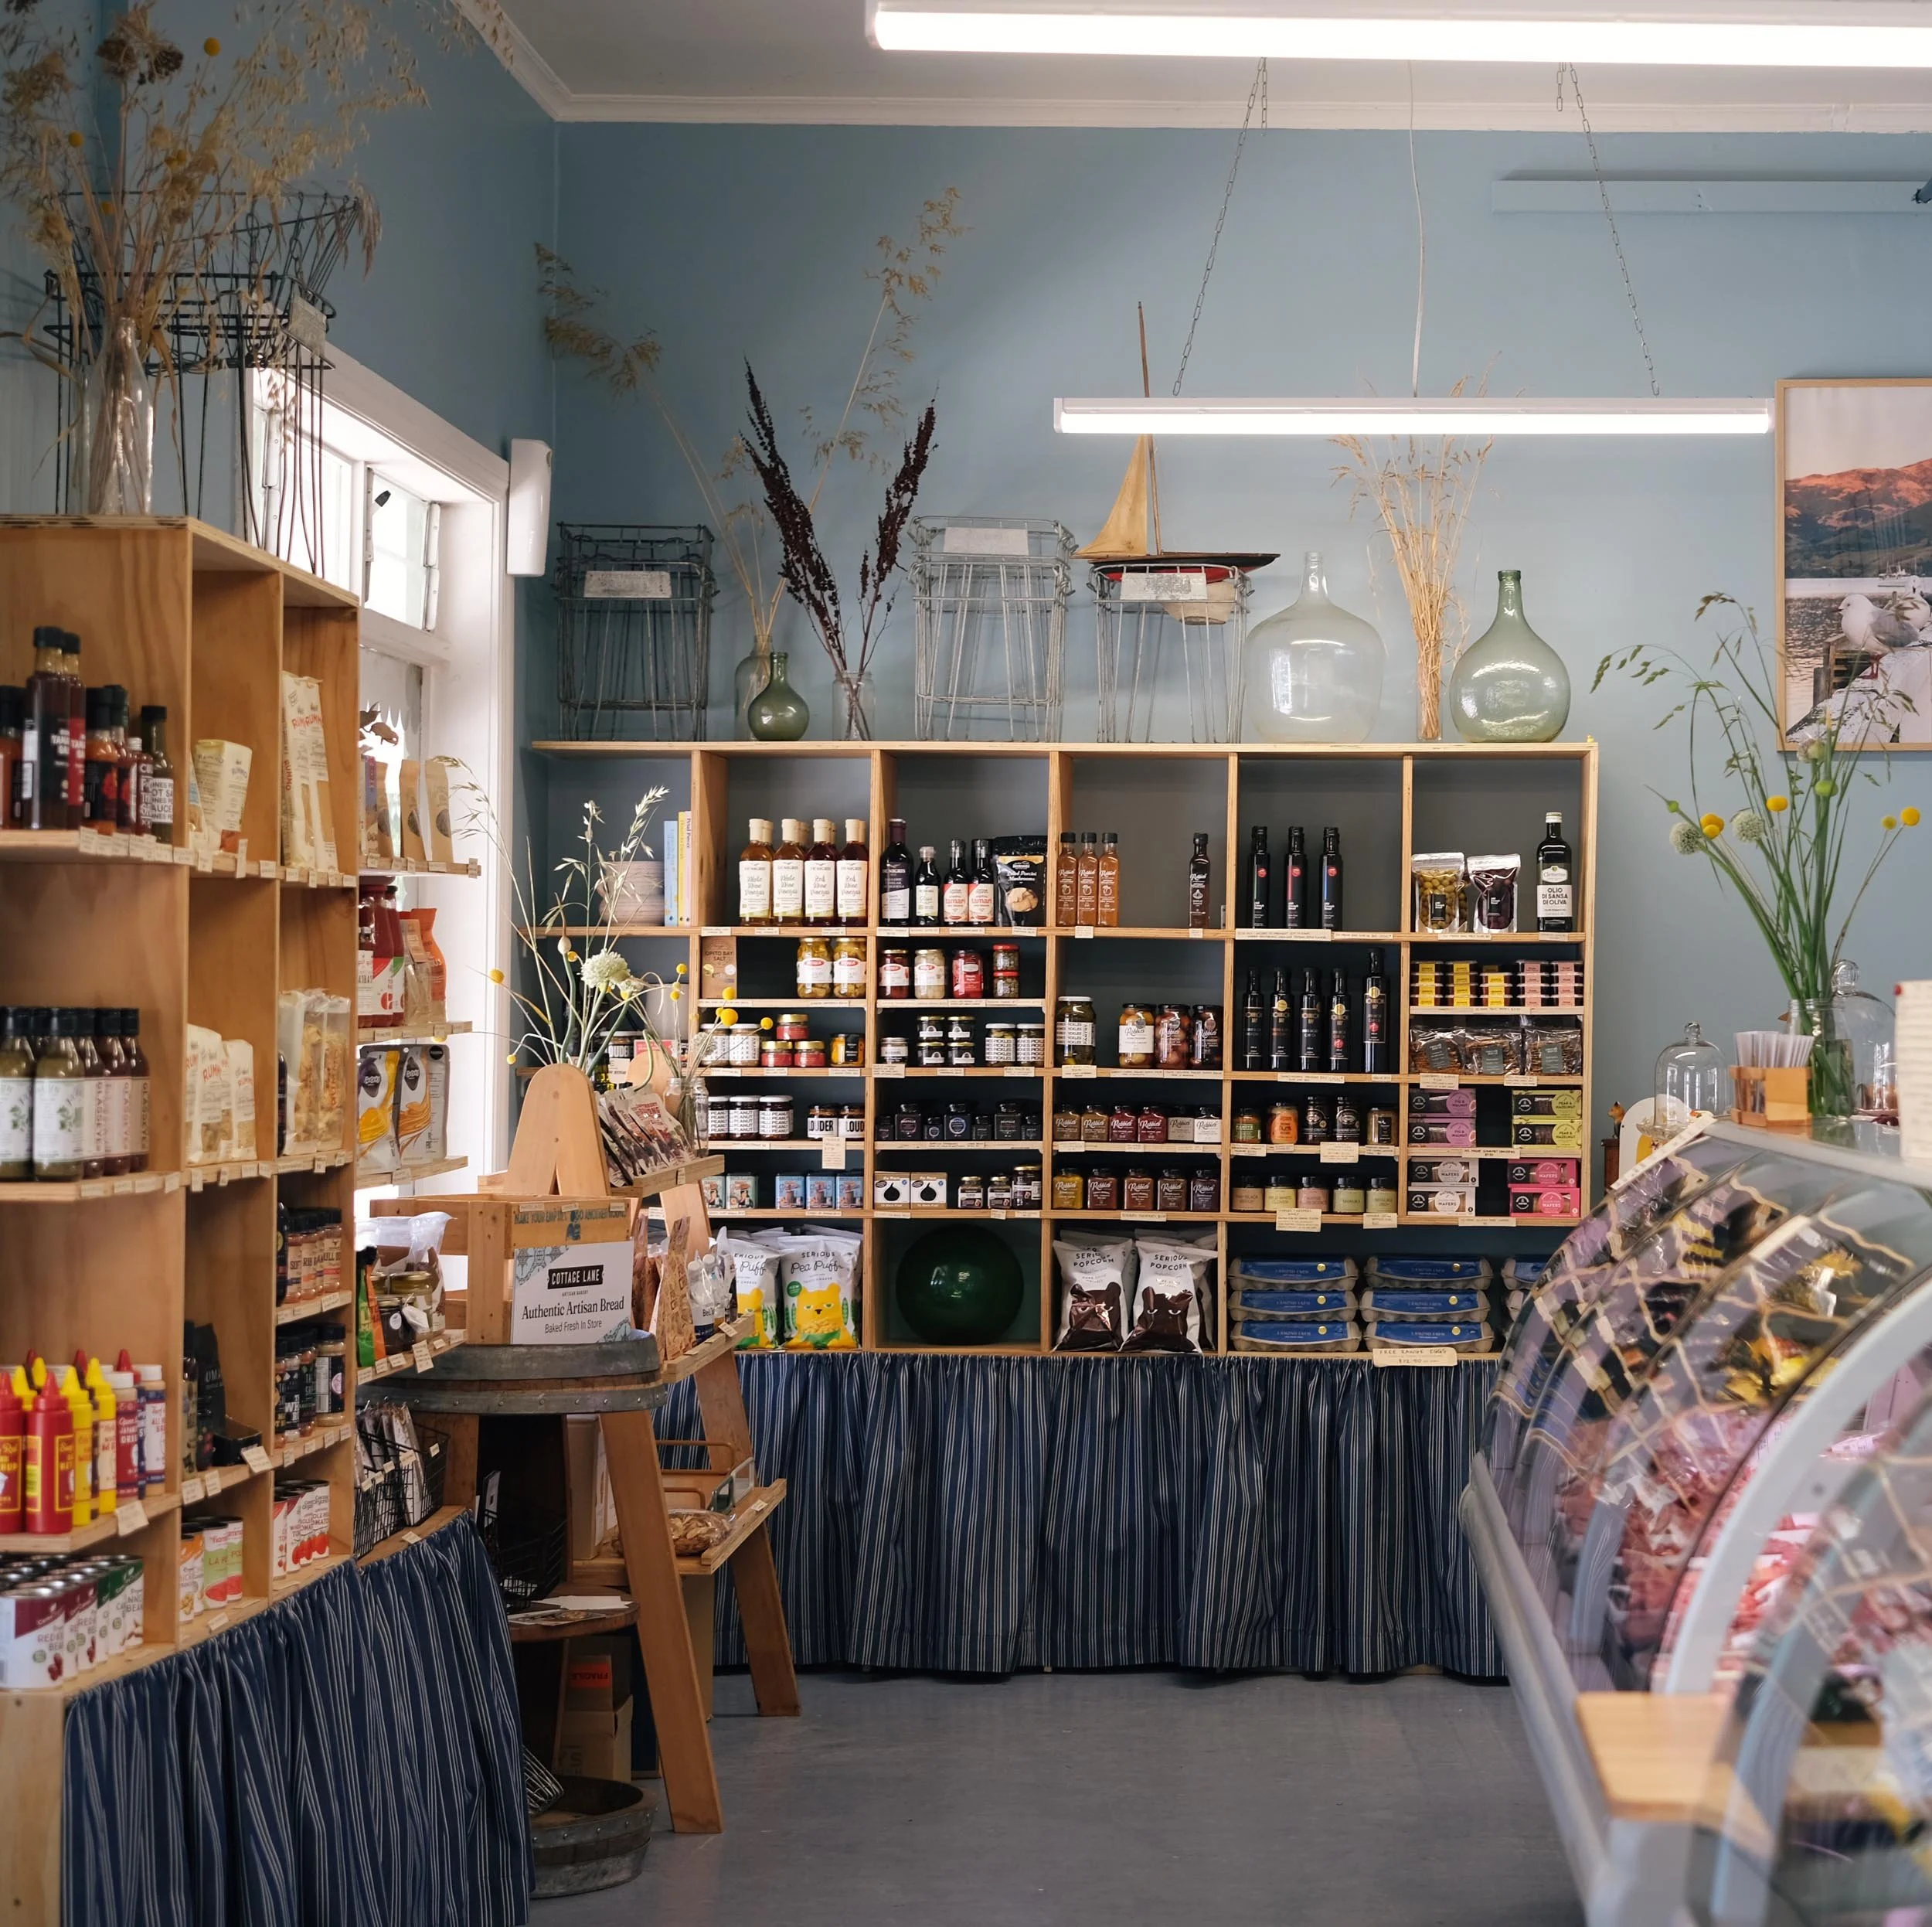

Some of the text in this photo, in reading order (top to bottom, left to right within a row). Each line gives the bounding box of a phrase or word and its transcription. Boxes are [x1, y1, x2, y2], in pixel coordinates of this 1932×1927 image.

[791, 1261, 811, 1274] Pea
[1150, 1262, 1187, 1271] POPCORN
[551, 1268, 600, 1285] COTTAGE LANE
[522, 1296, 624, 1319] Authentic Artisan Bread
[545, 1319, 602, 1333] Baked Fresh In Store
